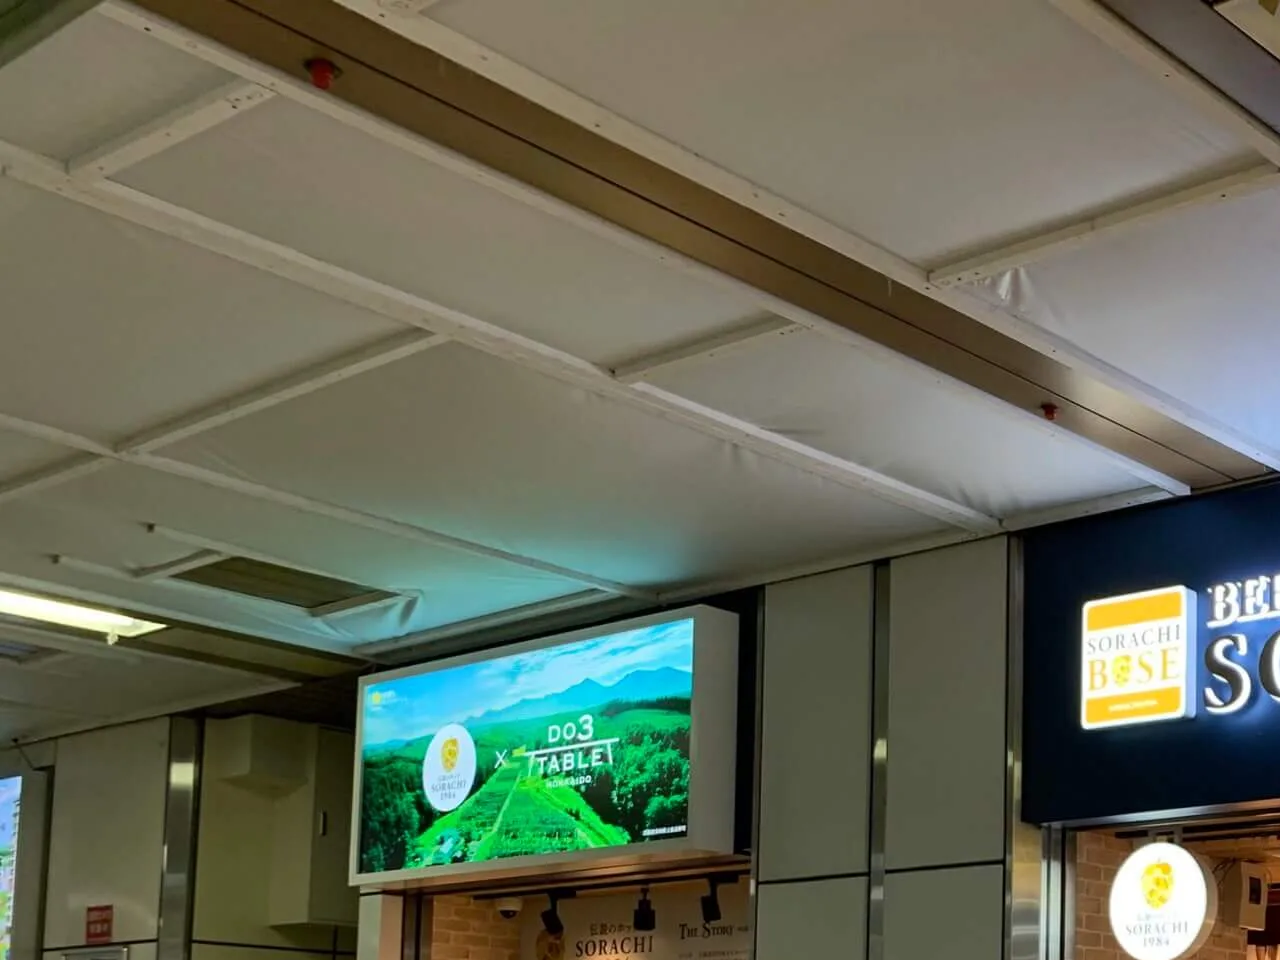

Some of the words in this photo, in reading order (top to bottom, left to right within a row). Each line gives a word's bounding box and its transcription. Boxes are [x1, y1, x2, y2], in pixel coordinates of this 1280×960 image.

[1086, 623, 1181, 655] SORACHI
[547, 714, 595, 743] DO3
[538, 747, 605, 774] TABLE
[702, 922, 734, 939] STORY
[1124, 920, 1190, 937] SORACHI
[575, 935, 654, 957] SORACHI
